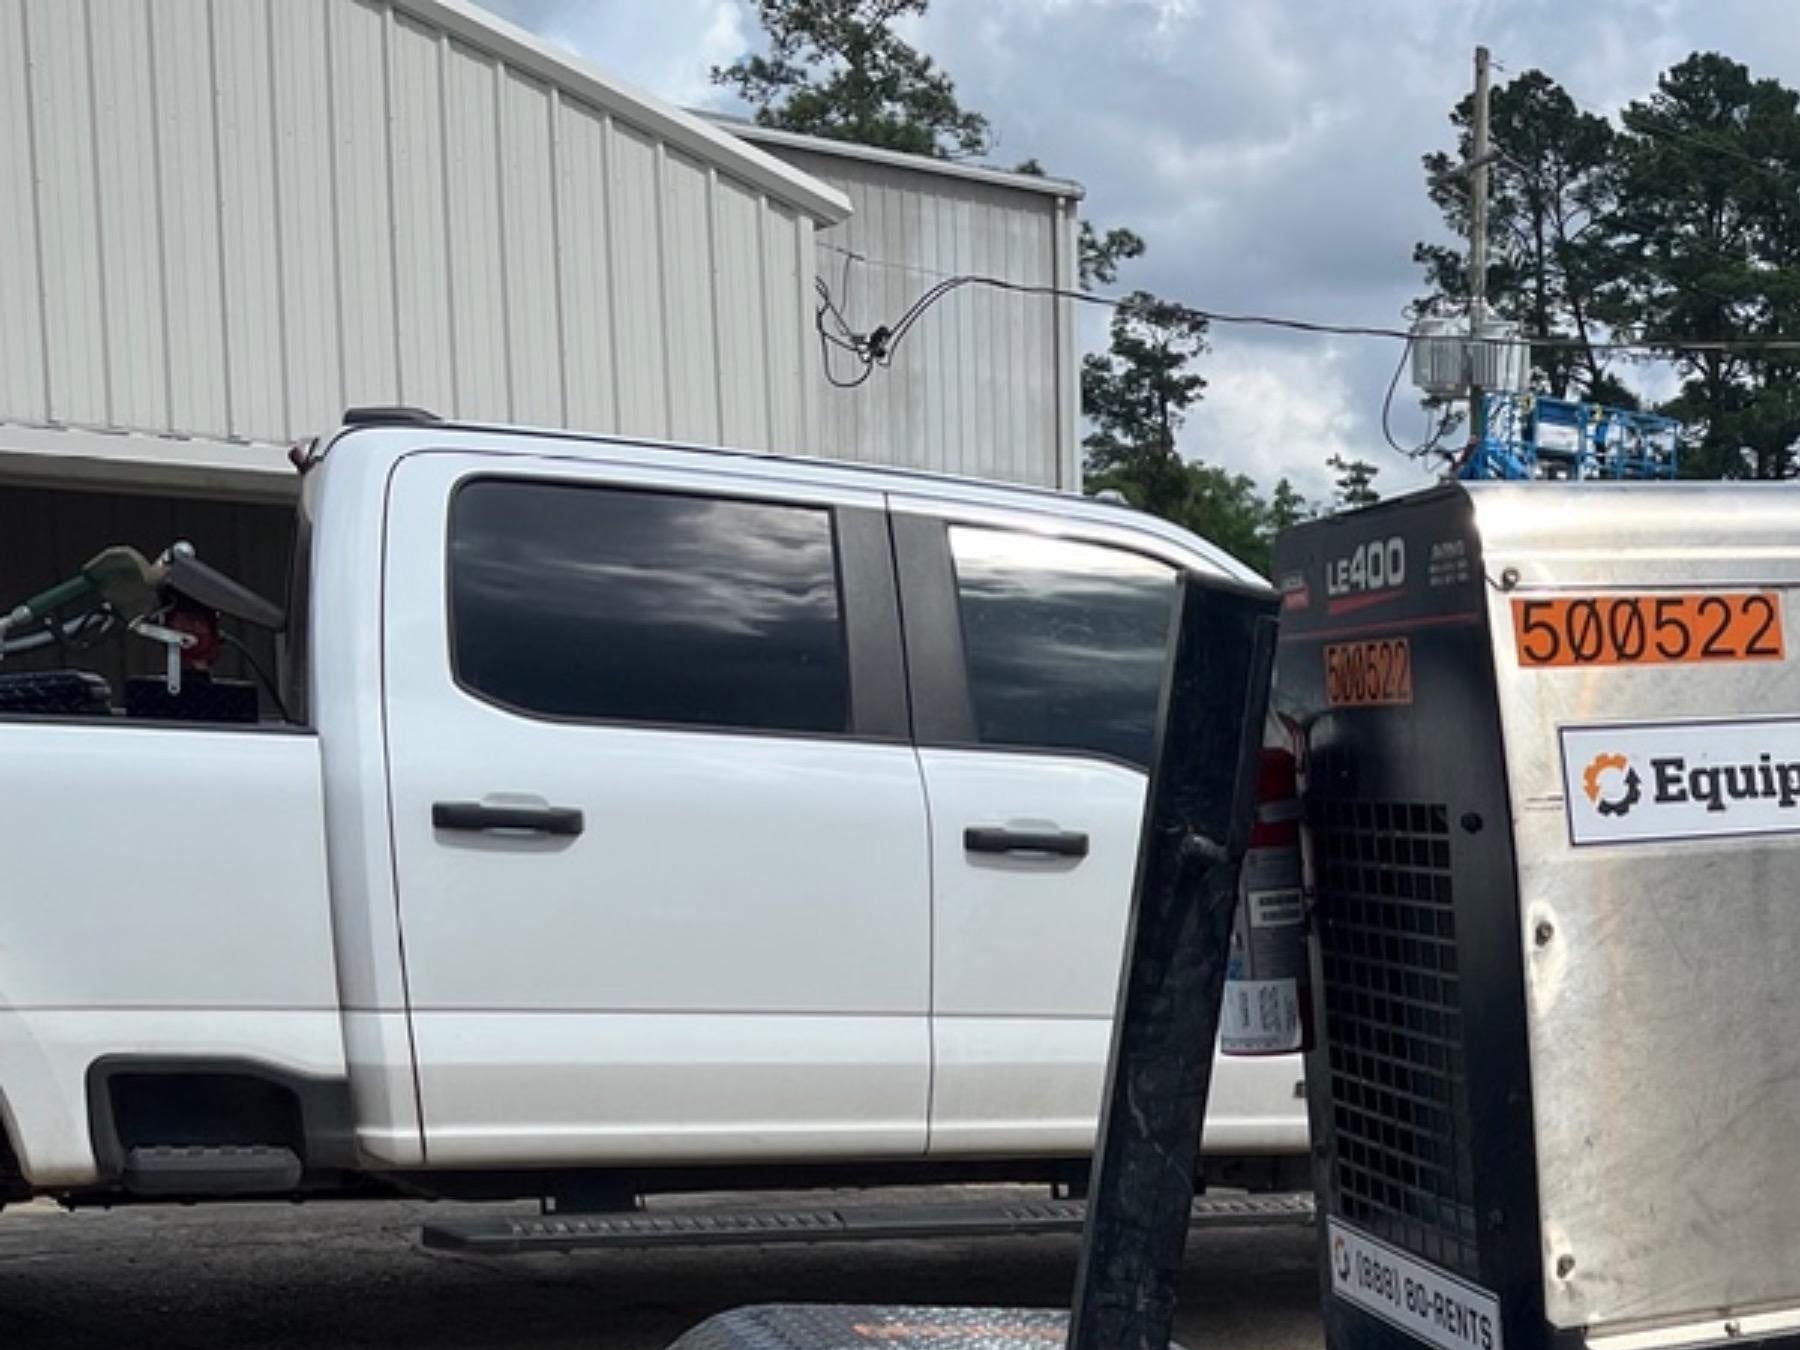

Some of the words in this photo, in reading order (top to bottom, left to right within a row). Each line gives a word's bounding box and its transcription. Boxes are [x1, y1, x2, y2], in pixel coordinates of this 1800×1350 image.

[1326, 536, 1406, 596] LE400
[1523, 597, 1780, 662] 500522
[1327, 641, 1409, 703] 500522
[1356, 1250, 1401, 1308] (888)
